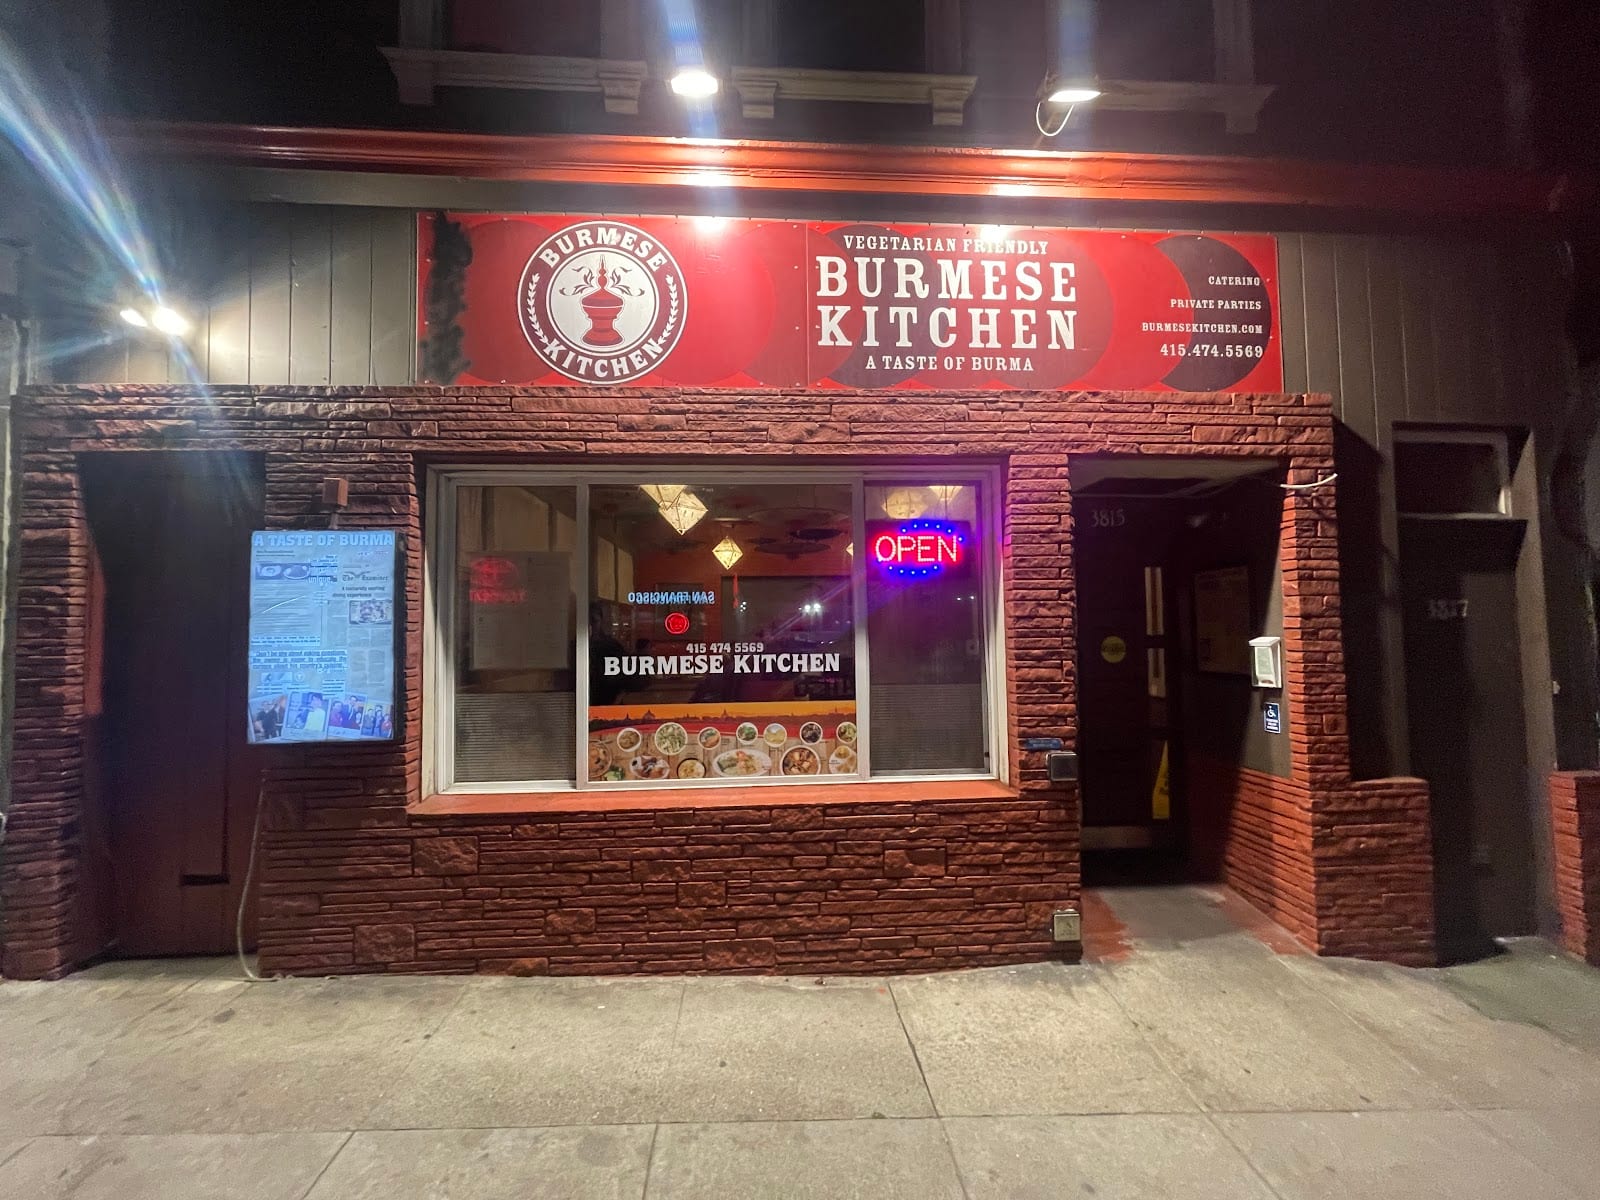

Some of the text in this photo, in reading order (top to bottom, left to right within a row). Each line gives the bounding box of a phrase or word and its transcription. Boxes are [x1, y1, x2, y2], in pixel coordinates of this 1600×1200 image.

[539, 226, 668, 272] BURMESE
[843, 235, 1049, 255] VEGETARIAN FRIENDLY
[816, 256, 1077, 303] BURMESE
[1208, 276, 1261, 286] CATERING
[1170, 298, 1262, 310] PRIVATE PARTIES
[817, 305, 1077, 350] KITCHEN
[1142, 322, 1263, 334] BURMESEKITCHEN.COM
[543, 336, 664, 378] KITCHEN
[1160, 343, 1264, 358] 415.474.5569
[865, 356, 1034, 372] A TASTE OF BURMA
[1089, 508, 1126, 528] 3815
[254, 533, 393, 546] A TASTE OF BURMA
[875, 535, 957, 562] OPEN
[686, 642, 764, 654] 415 474 5569
[604, 653, 840, 676] BURMESE KITCHEN
